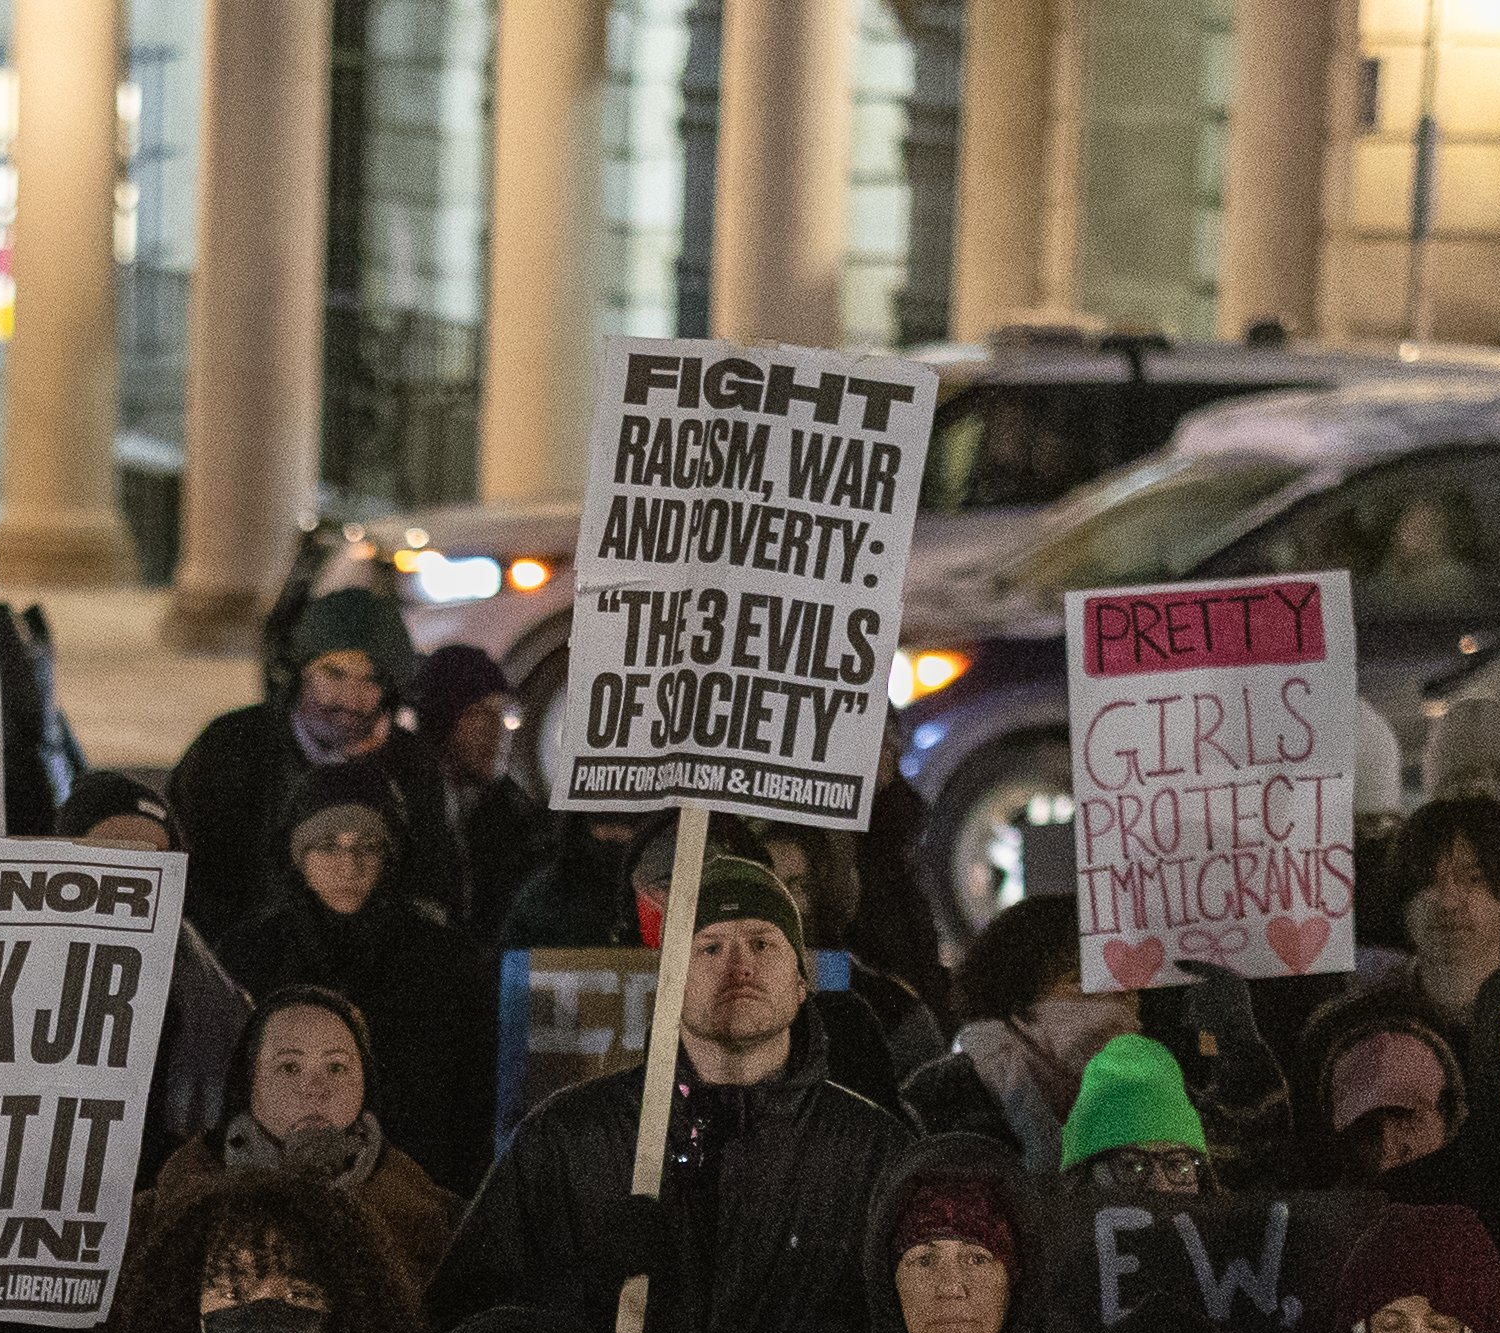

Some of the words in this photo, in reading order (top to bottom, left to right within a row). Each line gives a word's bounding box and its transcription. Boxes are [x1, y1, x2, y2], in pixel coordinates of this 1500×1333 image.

[623, 353, 915, 432] FIGHT
[613, 414, 774, 501] RACISM,
[789, 429, 902, 514] WAR
[598, 495, 687, 564] AND
[685, 499, 885, 589] POVERTY:
[691, 588, 729, 666] 3
[730, 592, 881, 686] EVILS
[1097, 584, 1318, 675] PRETTY
[586, 672, 651, 749] OF
[1083, 676, 1315, 792] GIRLS
[574, 764, 626, 792] PARTY
[626, 764, 657, 792] FOR
[727, 769, 750, 793] &
[753, 771, 855, 811] LIBERATION
[1081, 772, 1343, 866] PROTECT
[1078, 842, 1355, 937] IMMIGRANTS
[30, 942, 144, 1068] JR
[41, 1097, 125, 1215] IT
[7, 1274, 101, 1306] LIBERATION
